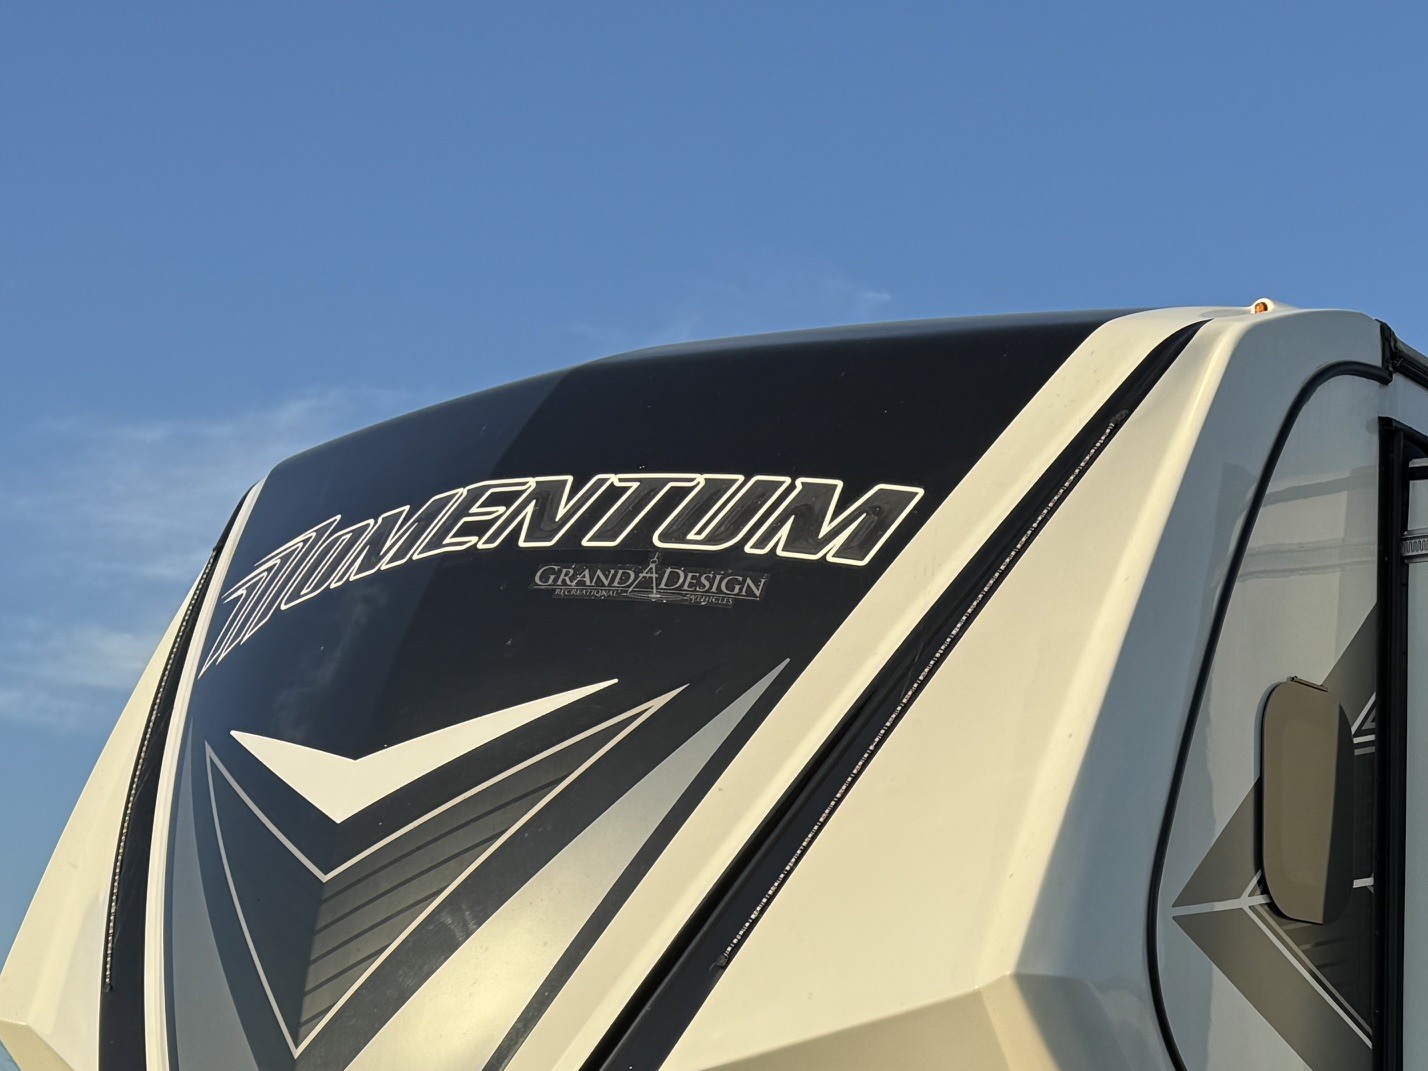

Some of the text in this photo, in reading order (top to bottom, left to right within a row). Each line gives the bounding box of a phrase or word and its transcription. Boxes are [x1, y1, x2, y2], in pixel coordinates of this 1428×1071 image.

[197, 474, 925, 681] MOMENTUM
[534, 565, 768, 598] GRAND DESIGN
